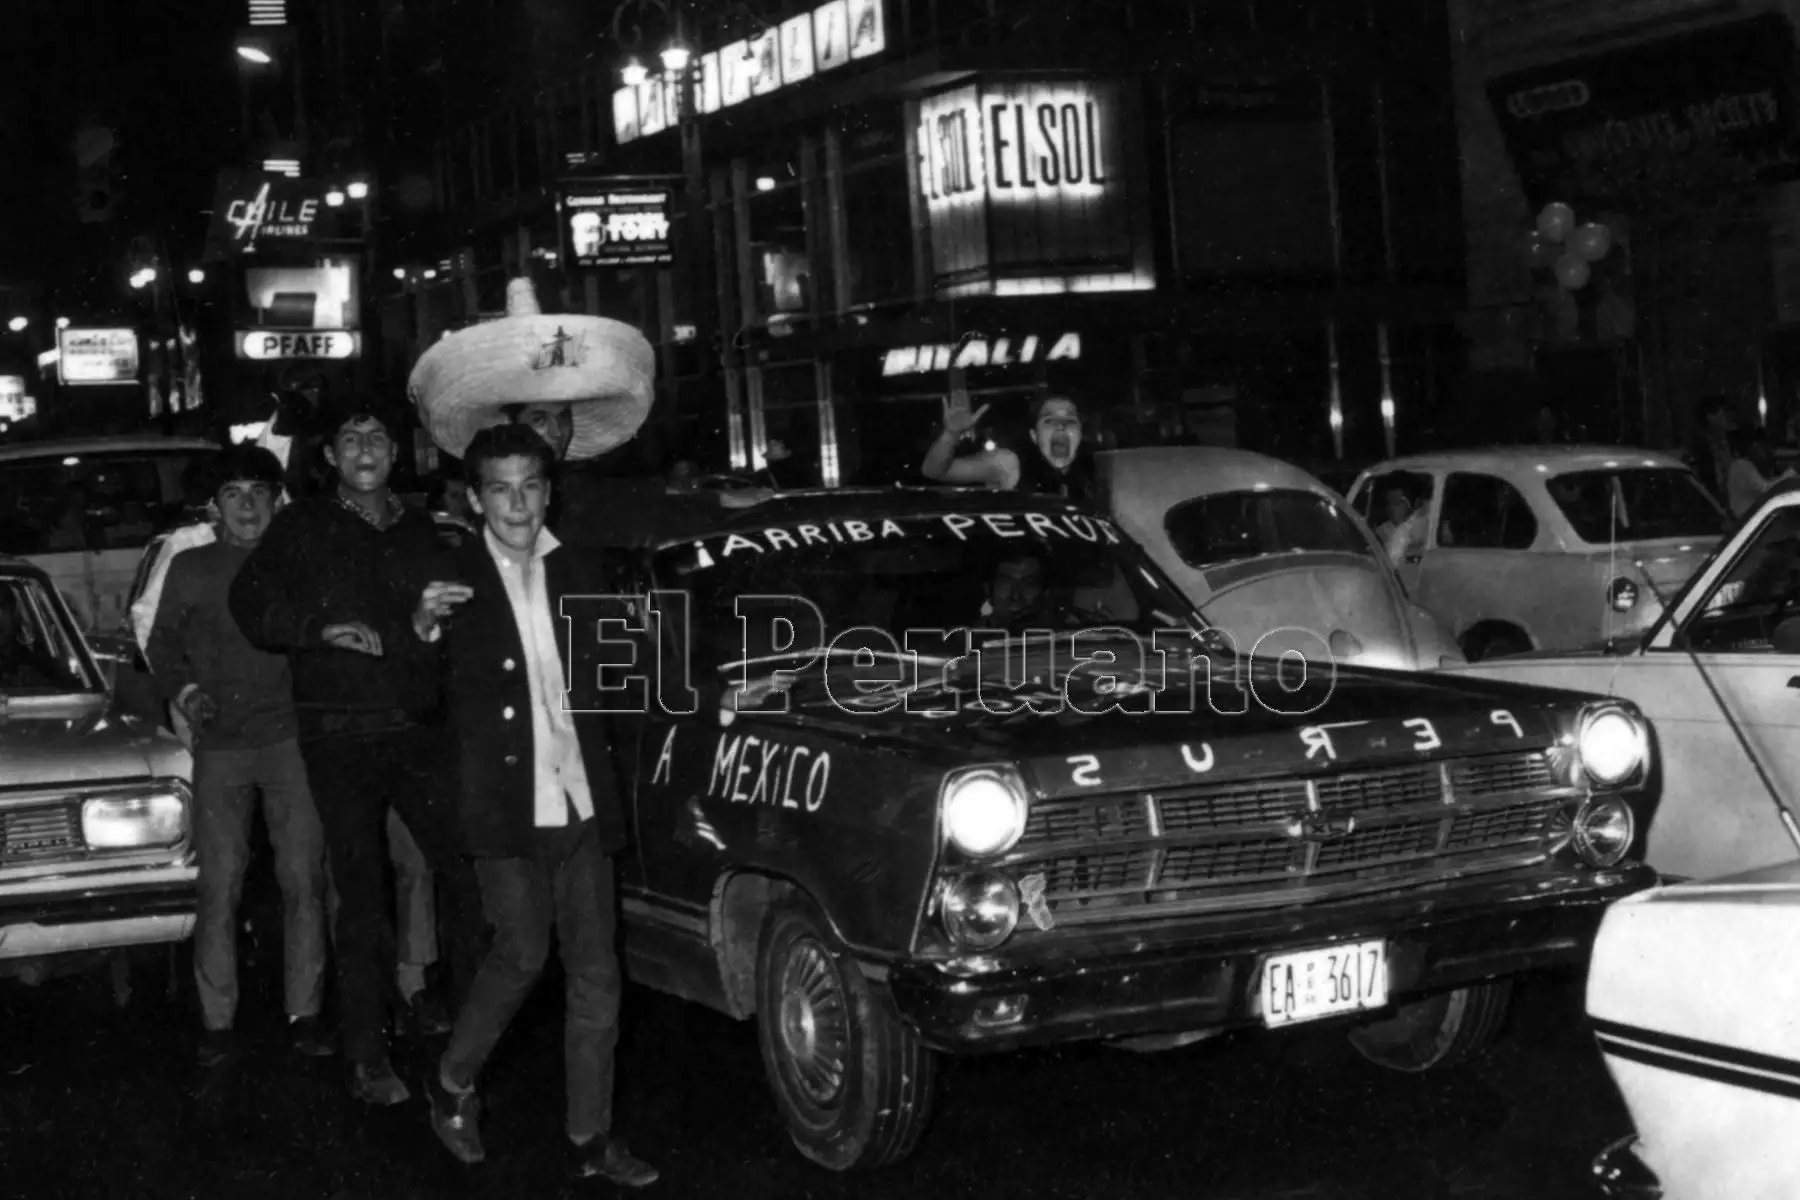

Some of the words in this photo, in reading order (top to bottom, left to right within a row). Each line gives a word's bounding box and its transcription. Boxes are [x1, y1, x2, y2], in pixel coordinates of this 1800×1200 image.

[263, 336, 335, 356] PFAFF
[652, 724, 678, 785] A
[1270, 963, 1296, 1014] EA
[1328, 950, 1379, 1004] 3617
